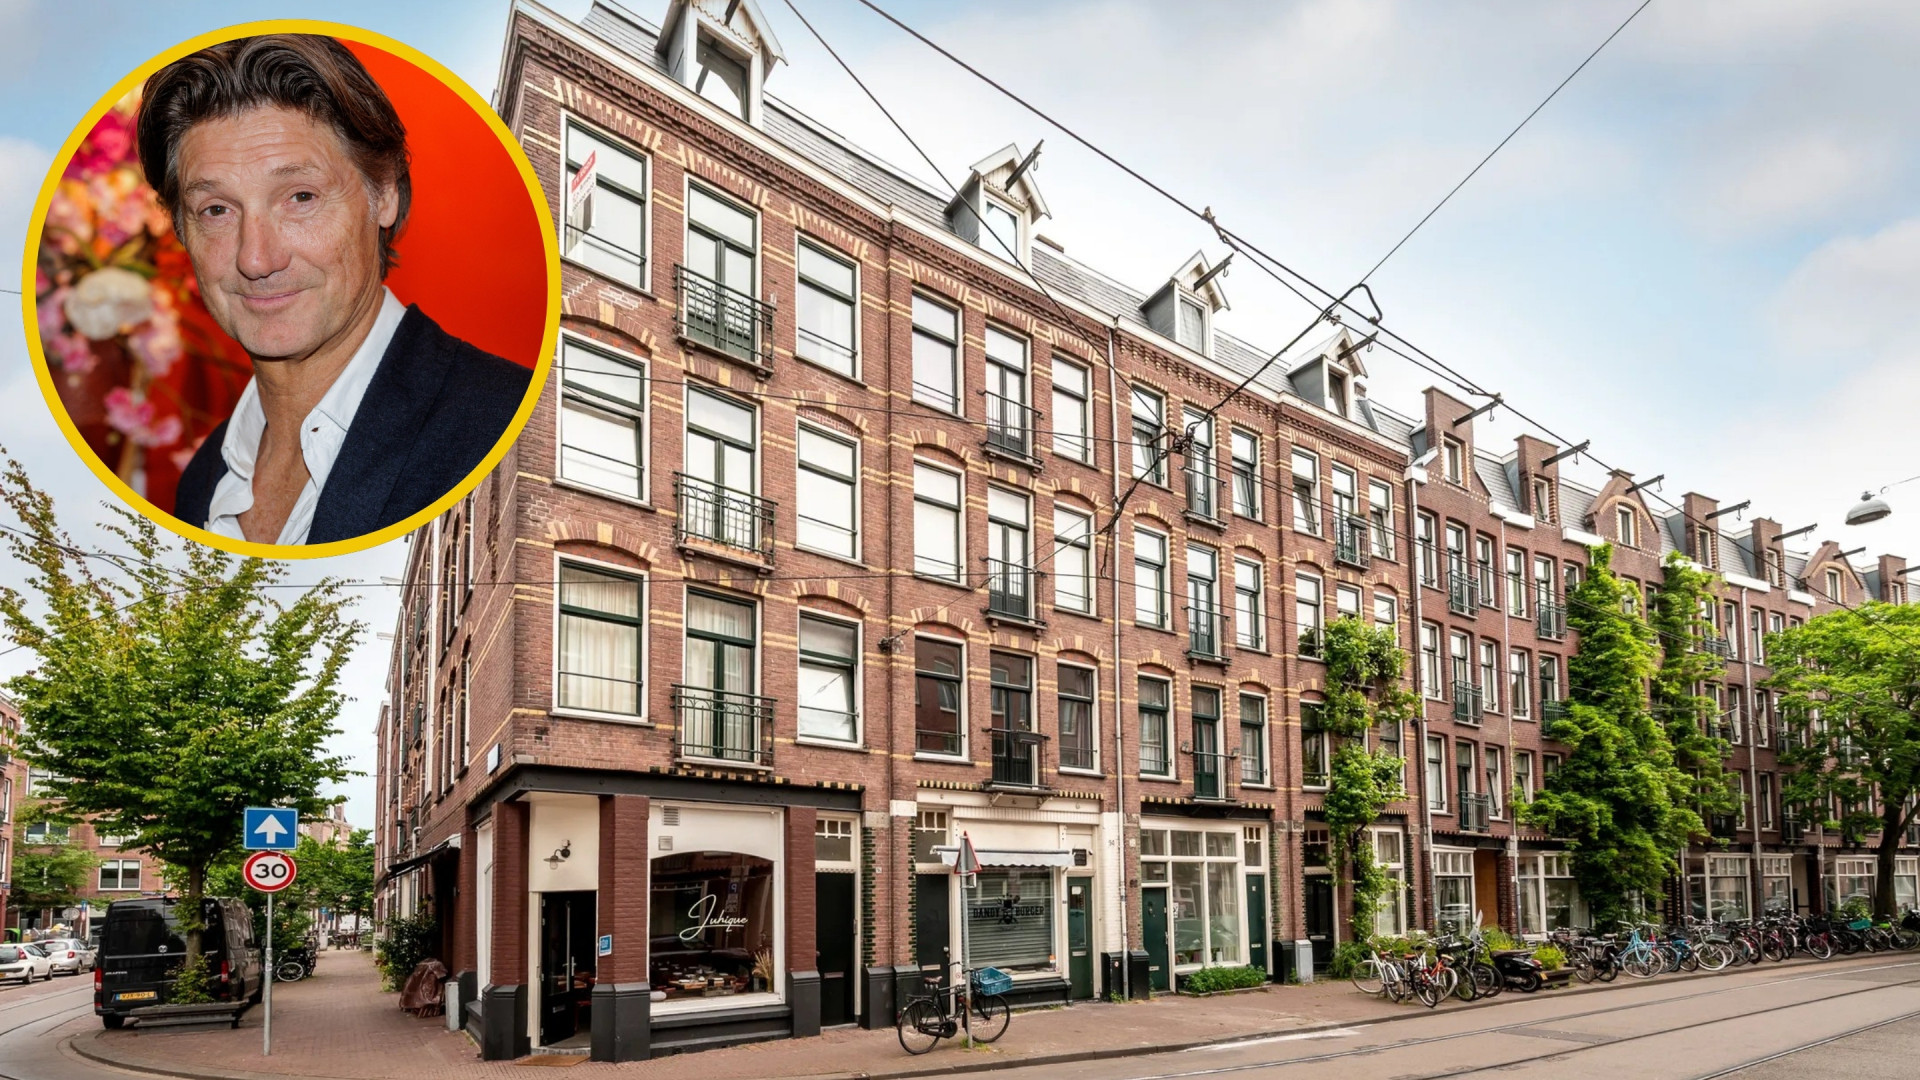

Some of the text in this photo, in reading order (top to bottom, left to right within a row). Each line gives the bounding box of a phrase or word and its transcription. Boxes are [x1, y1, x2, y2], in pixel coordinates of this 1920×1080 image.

[254, 863, 287, 879] 30
[973, 905, 1044, 918] DANDY BURGER
